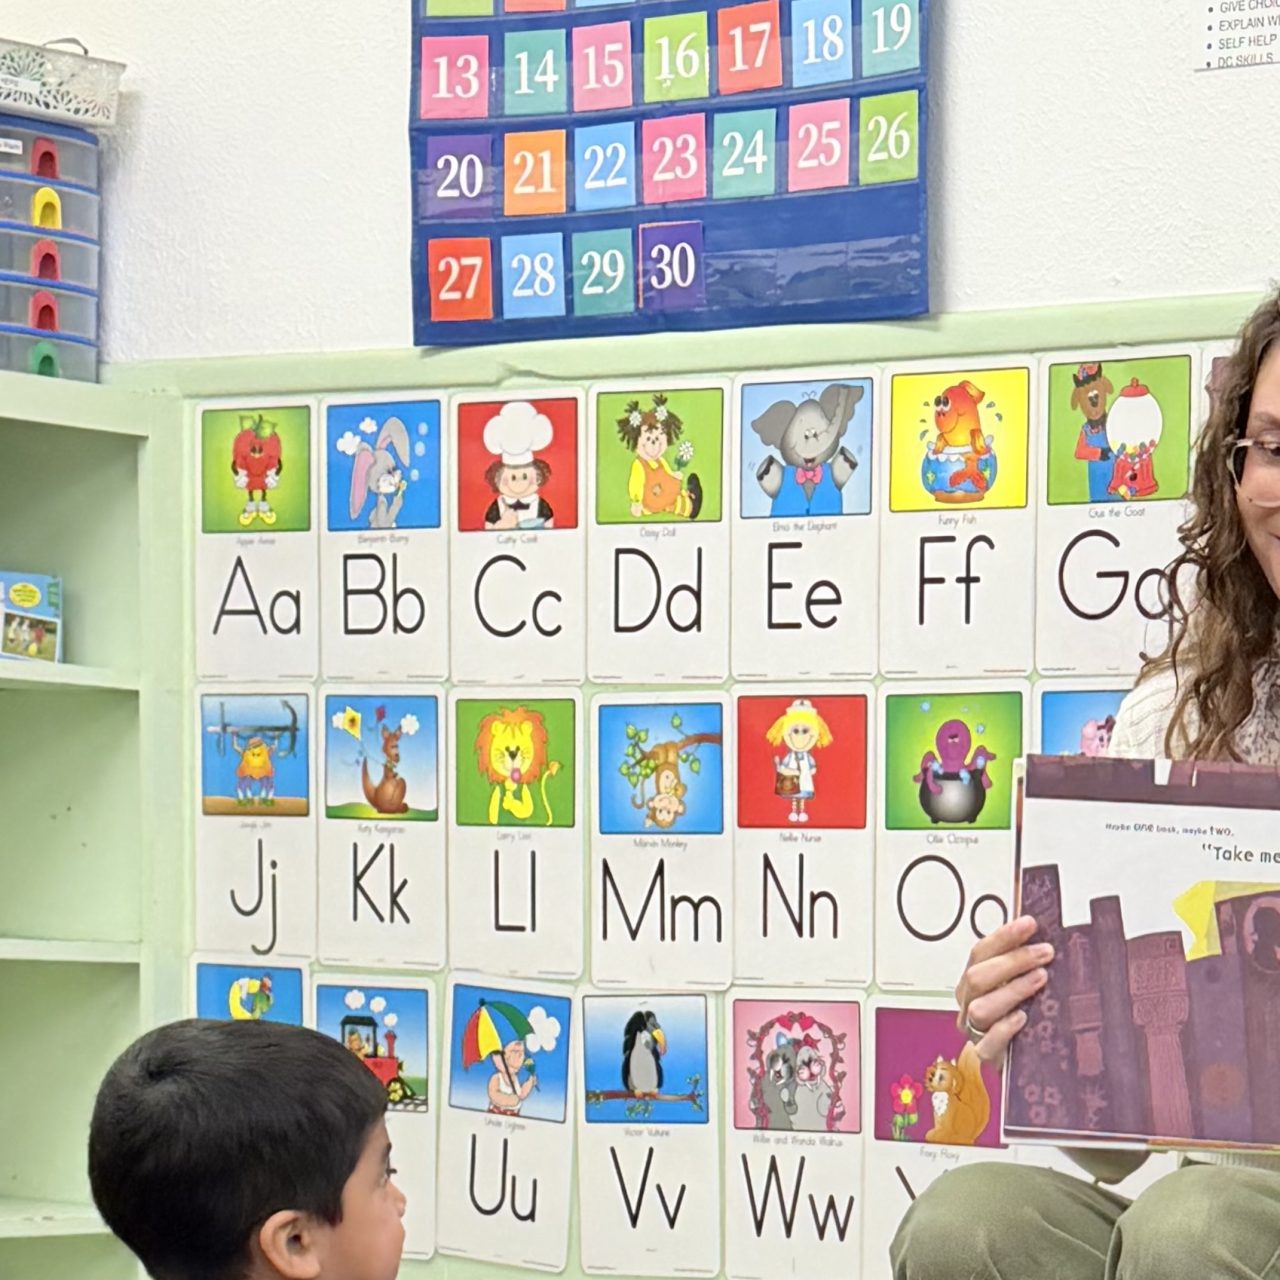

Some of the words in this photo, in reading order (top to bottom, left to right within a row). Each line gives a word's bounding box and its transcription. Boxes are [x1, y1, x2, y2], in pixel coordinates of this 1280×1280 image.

[1218, 36, 1246, 50] SELF
[1248, 33, 1278, 47] HELP
[1219, 16, 1265, 32] EXPLAIN
[1220, 0, 1246, 13] GIVE
[432, 54, 480, 98] 13
[515, 50, 558, 94] 14
[583, 43, 625, 89] 15
[656, 32, 700, 81] 16
[729, 22, 772, 73] 17
[801, 14, 845, 65] 18
[871, 3, 912, 55] 19
[1218, 56, 1233, 68] DC
[1236, 52, 1274, 67] SKILLS
[436, 153, 484, 199] 20
[513, 150, 556, 195] 21
[584, 142, 628, 190] 22
[652, 133, 699, 182] 23
[722, 129, 769, 177] 24
[797, 120, 842, 169] 25
[867, 111, 911, 162] 26
[438, 255, 484, 302] 27
[511, 252, 557, 298] 28
[580, 249, 626, 295] 29
[650, 241, 696, 290] 30
[663, 526, 676, 537] Doll
[938, 513, 959, 529] Funny
[962, 513, 976, 525] Fish
[1088, 507, 1105, 518] Gus
[1109, 507, 1121, 517] the
[1124, 505, 1145, 517] Goat
[212, 555, 301, 637] Aa
[343, 552, 426, 635] Bb
[474, 554, 562, 638] Cc
[614, 546, 702, 633] Dd
[767, 541, 842, 630] Ee
[919, 534, 995, 626] Ff
[353, 842, 410, 924] Kk
[494, 849, 536, 933] Ll
[1202, 843, 1254, 862] "Take
[230, 838, 278, 956] Jj
[602, 857, 723, 943] Mm
[762, 852, 838, 938] Nn
[896, 854, 1008, 941] Oo
[469, 1133, 537, 1223] Uu
[610, 1146, 686, 1229] Vv
[741, 1152, 855, 1241] Ww
